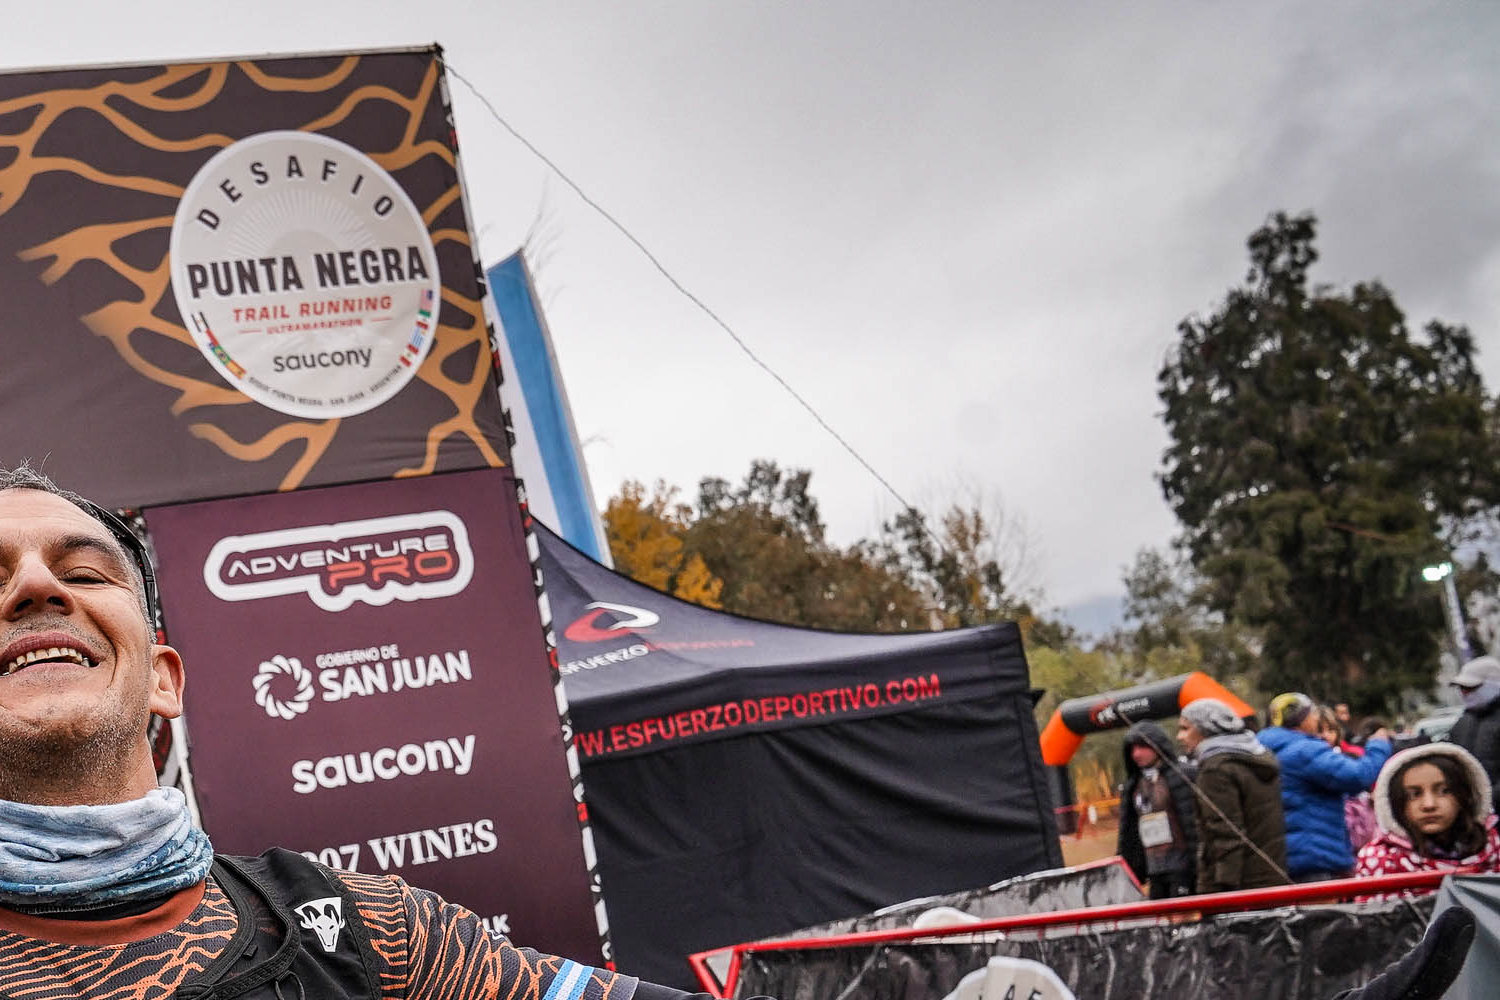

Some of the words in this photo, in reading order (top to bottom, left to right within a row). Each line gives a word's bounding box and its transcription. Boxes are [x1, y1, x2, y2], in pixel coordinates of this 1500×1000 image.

[197, 155, 394, 230] DESAFIO
[187, 255, 303, 299] PUNTA
[314, 246, 429, 288] NEGRA
[233, 305, 290, 322] TRAIL
[299, 296, 392, 317] RUNNING
[273, 348, 372, 373] saucony
[227, 533, 450, 579] ADVENTURE
[327, 550, 453, 590] PRO
[315, 646, 380, 669] GOBIERNO
[380, 644, 399, 660] DE
[318, 662, 389, 702] SAN
[392, 650, 472, 692] JUAN
[559, 643, 649, 676] SFUERZO
[292, 734, 476, 794] saucony
[367, 818, 499, 871] WINES
